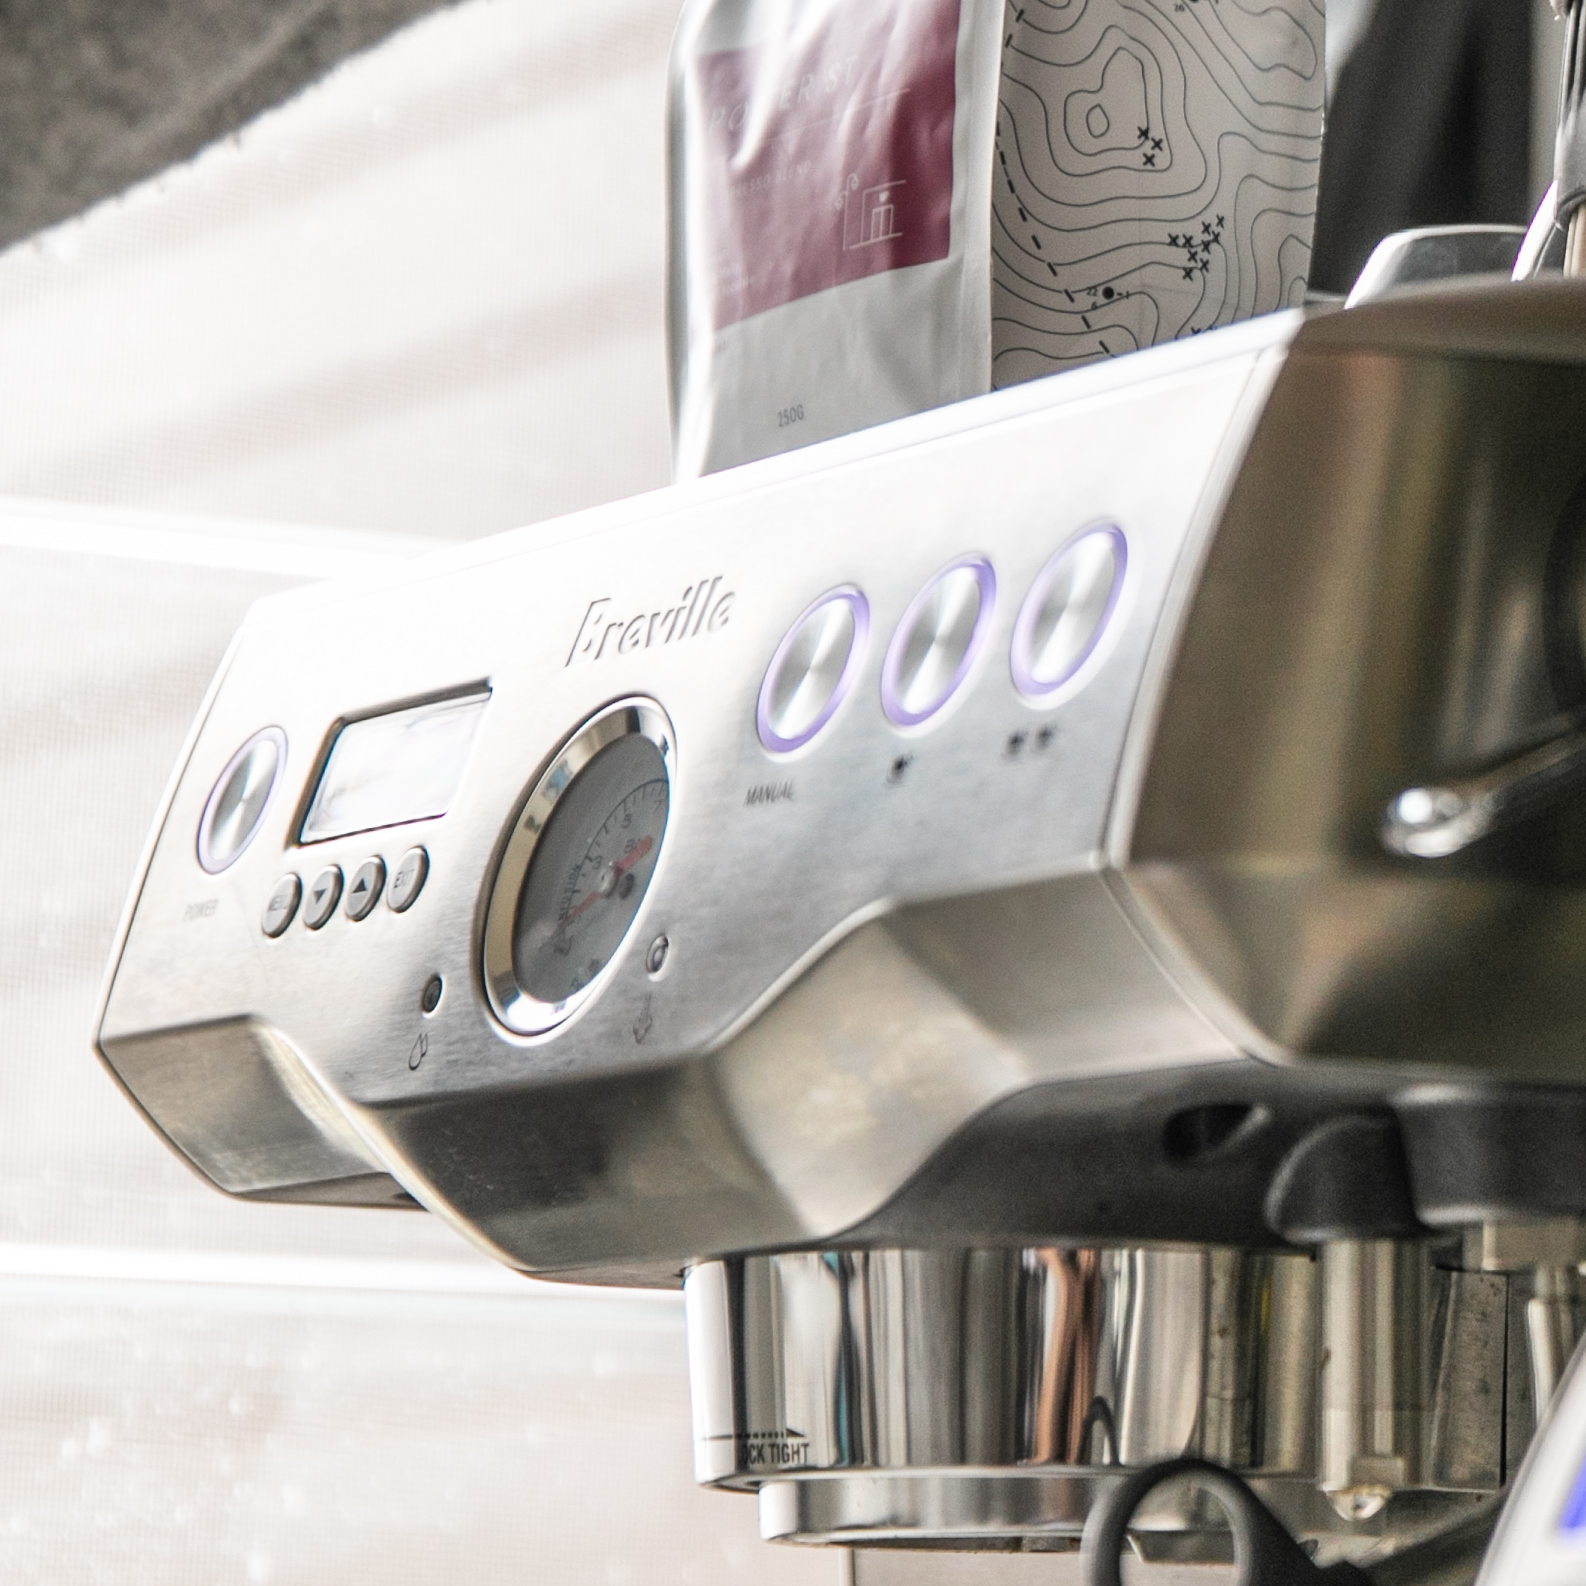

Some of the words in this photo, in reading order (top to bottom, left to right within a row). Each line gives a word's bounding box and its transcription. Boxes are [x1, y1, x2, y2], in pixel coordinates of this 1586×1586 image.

[776, 404, 805, 428] 250G
[564, 574, 736, 668] Breville
[743, 779, 794, 806] MANUAL
[182, 899, 218, 923] POWER
[768, 1442, 809, 1465] TIGHT
